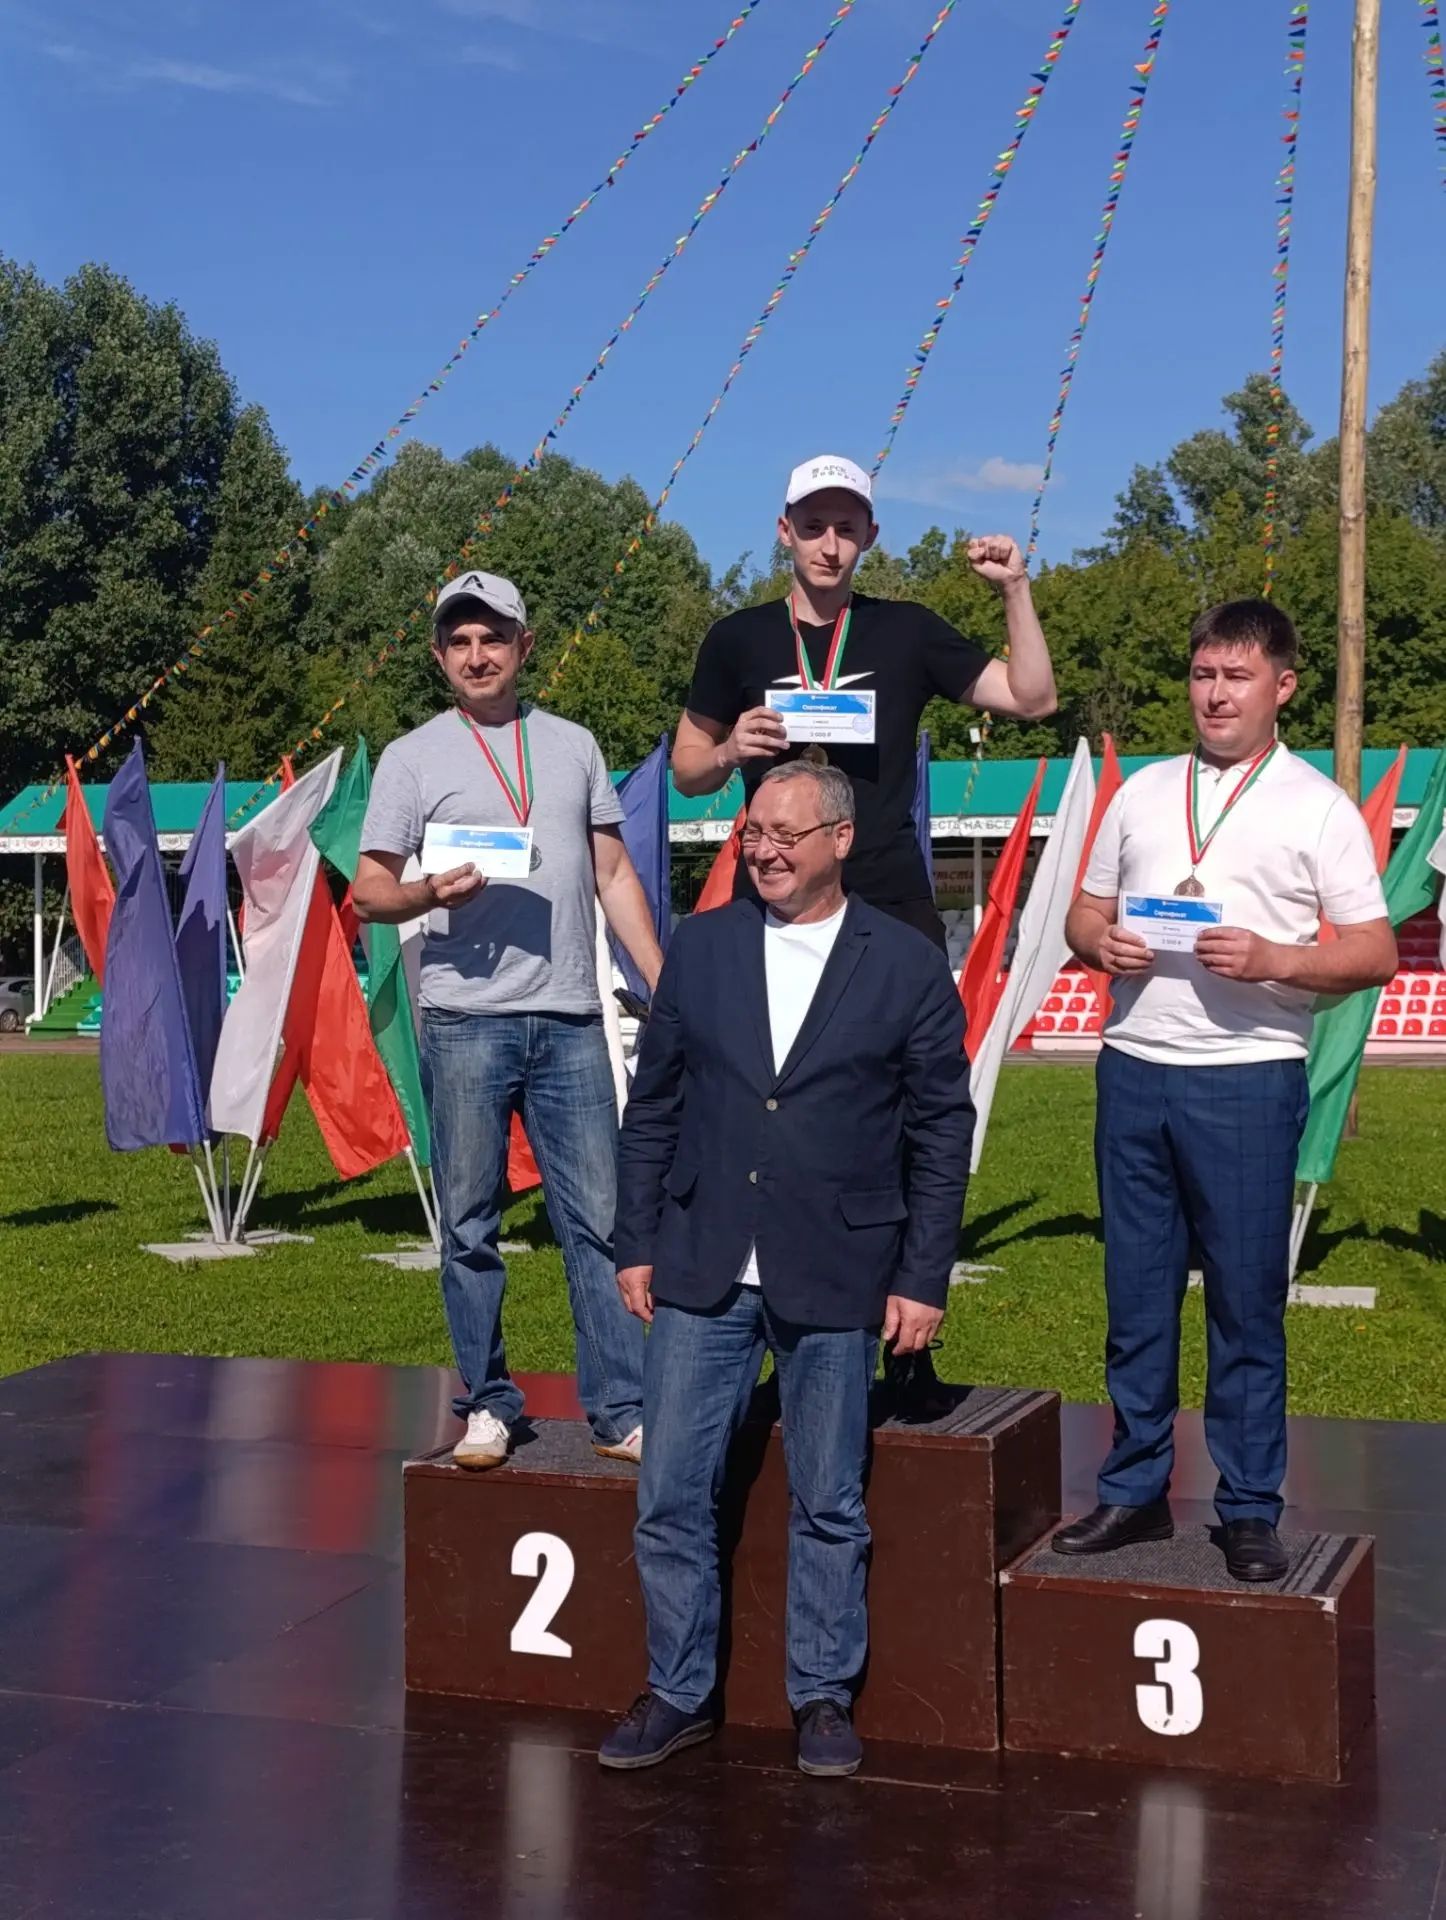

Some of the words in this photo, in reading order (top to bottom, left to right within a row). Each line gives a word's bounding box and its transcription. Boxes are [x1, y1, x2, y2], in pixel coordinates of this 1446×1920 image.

[964, 820, 981, 831] НА
[985, 819, 1012, 830] ВСЕ
[509, 1531, 575, 1659] 2
[1132, 1618, 1205, 1737] 3
